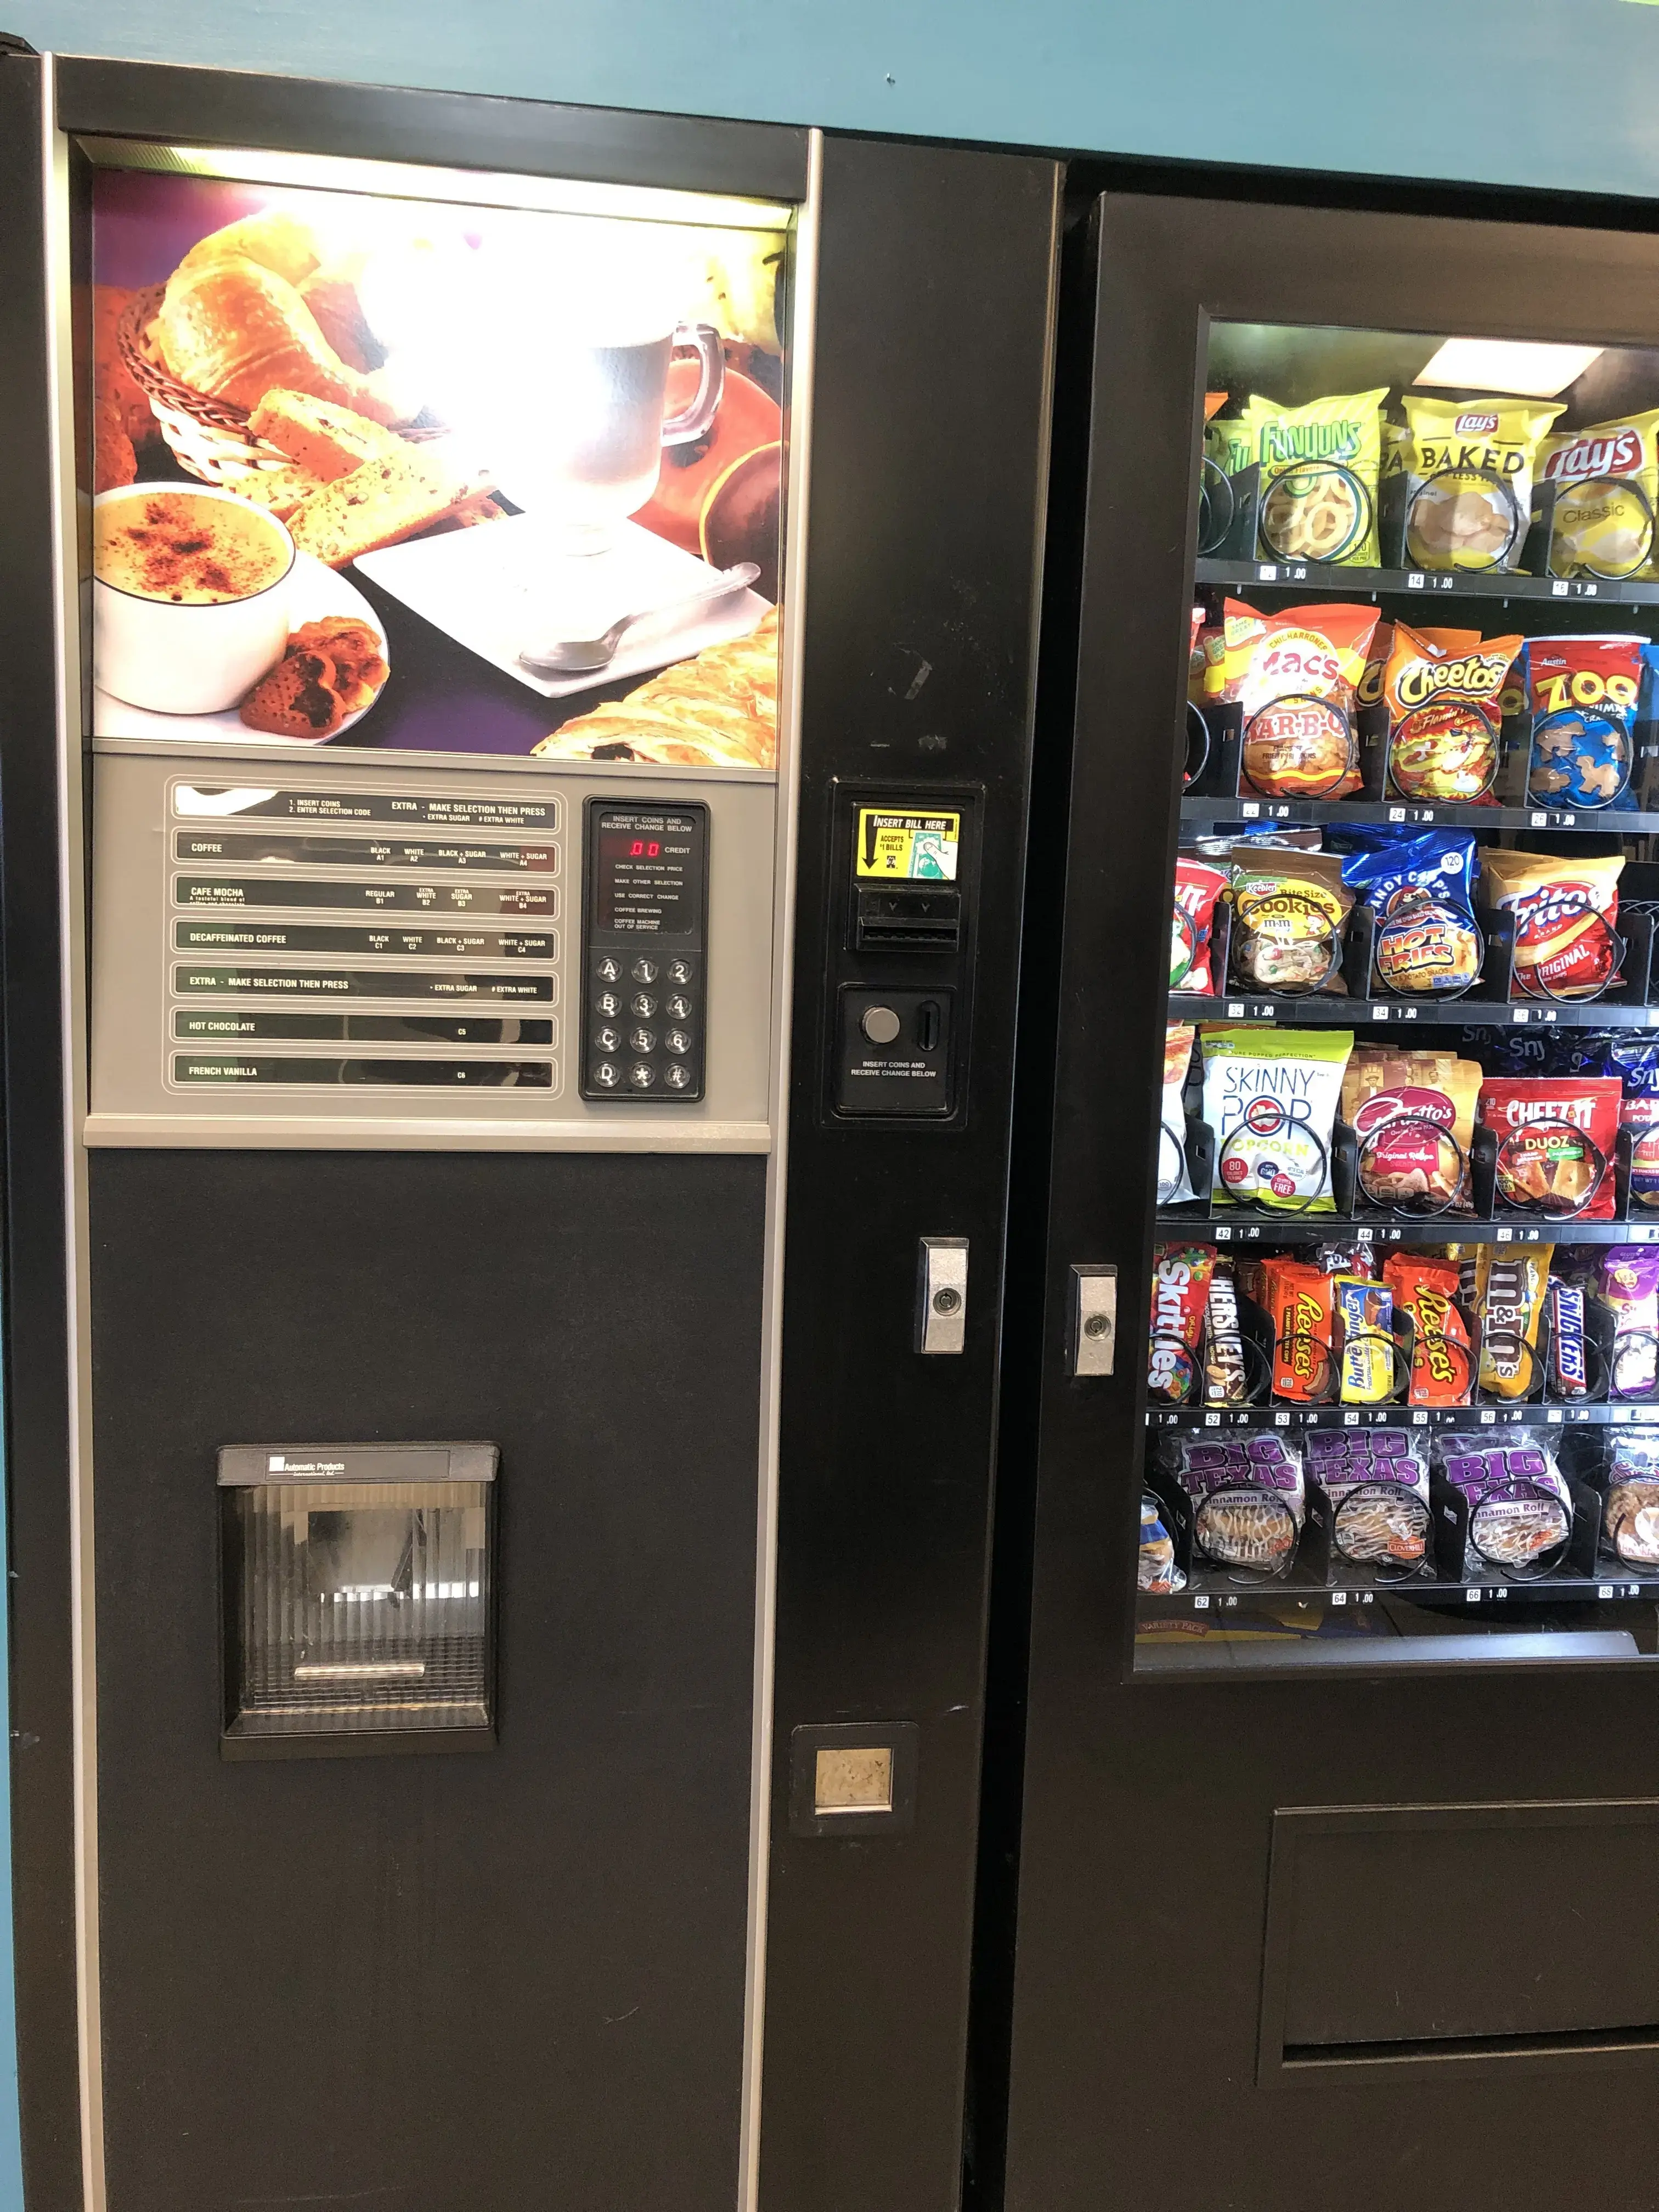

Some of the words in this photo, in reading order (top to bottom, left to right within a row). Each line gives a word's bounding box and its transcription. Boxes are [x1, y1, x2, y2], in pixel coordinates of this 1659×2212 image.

[1456, 415, 1498, 432] Lay's
[1421, 445, 1525, 474] BAKED
[1562, 502, 1624, 523] Classic
[1541, 657, 1567, 666] Austin
[1399, 656, 1504, 704] Cheetos
[1536, 671, 1638, 713] ZOO
[392, 802, 417, 810] EXTRA
[429, 804, 452, 812] MAKE
[453, 804, 496, 814] SELECTION
[498, 806, 519, 815] THEN
[520, 807, 545, 816] PRESS
[873, 815, 902, 828] INSERT
[905, 819, 922, 829] BILL
[925, 820, 947, 830] HERE
[191, 843, 222, 852] COFFEE
[1445, 855, 1459, 866] 120
[191, 888, 212, 896] CAFE
[214, 888, 244, 897] MOCHA
[1247, 883, 1277, 893] Keebler
[1305, 890, 1327, 898] Size
[1370, 874, 1402, 909] ANDY
[1242, 898, 1335, 915] Cookies
[190, 933, 254, 943] DECAFFEINATED
[256, 935, 286, 944] COFFEE
[1381, 927, 1444, 956] HOT
[1379, 945, 1453, 974] FRIES
[603, 962, 616, 975] A
[675, 965, 685, 977] 2
[190, 977, 216, 985] EXTRA
[253, 979, 297, 988] SELECTION
[299, 980, 320, 988] THEN
[322, 980, 349, 989] PRESS
[603, 997, 614, 1009] B
[639, 998, 648, 1011] 3
[674, 1000, 684, 1011] 4
[189, 1022, 206, 1030] HOT
[208, 1022, 256, 1031] CHOCOLATE
[602, 1031, 614, 1045] C
[639, 1033, 647, 1046] 5
[673, 1034, 682, 1046] 6
[189, 1066, 221, 1075] FRENCH
[223, 1068, 257, 1076] VANILLA
[601, 1066, 612, 1079] D
[1223, 1066, 1315, 1096] SKINNY
[1221, 1095, 1312, 1140] POP
[1525, 1136, 1570, 1150] DUOZ
[1376, 1151, 1408, 1161] Original
[1229, 1161, 1241, 1170] 80
[1274, 1183, 1293, 1195] FREE
[1218, 1229, 1229, 1238] 42
[1148, 1260, 1190, 1389] Skittles
[1294, 1292, 1323, 1380] Reese's
[1208, 1415, 1218, 1424] 52
[1277, 1415, 1288, 1423] 53
[1347, 1414, 1357, 1423] 54
[1416, 1414, 1425, 1422] 55
[1308, 1430, 1409, 1458] BIG
[1186, 1438, 1285, 1469] BIG
[284, 1463, 315, 1471] Automatic
[1447, 1450, 1545, 1482] BIG
[1181, 1464, 1298, 1494] TEXAS
[1523, 1503, 1544, 1512] Roll
[1389, 1543, 1424, 1552] CLOVERHILL
[1197, 1598, 1207, 1606] 62
[1334, 1595, 1344, 1603] 64
[1142, 1622, 1178, 1630] VARIETY
[1181, 1622, 1205, 1633] PACK
